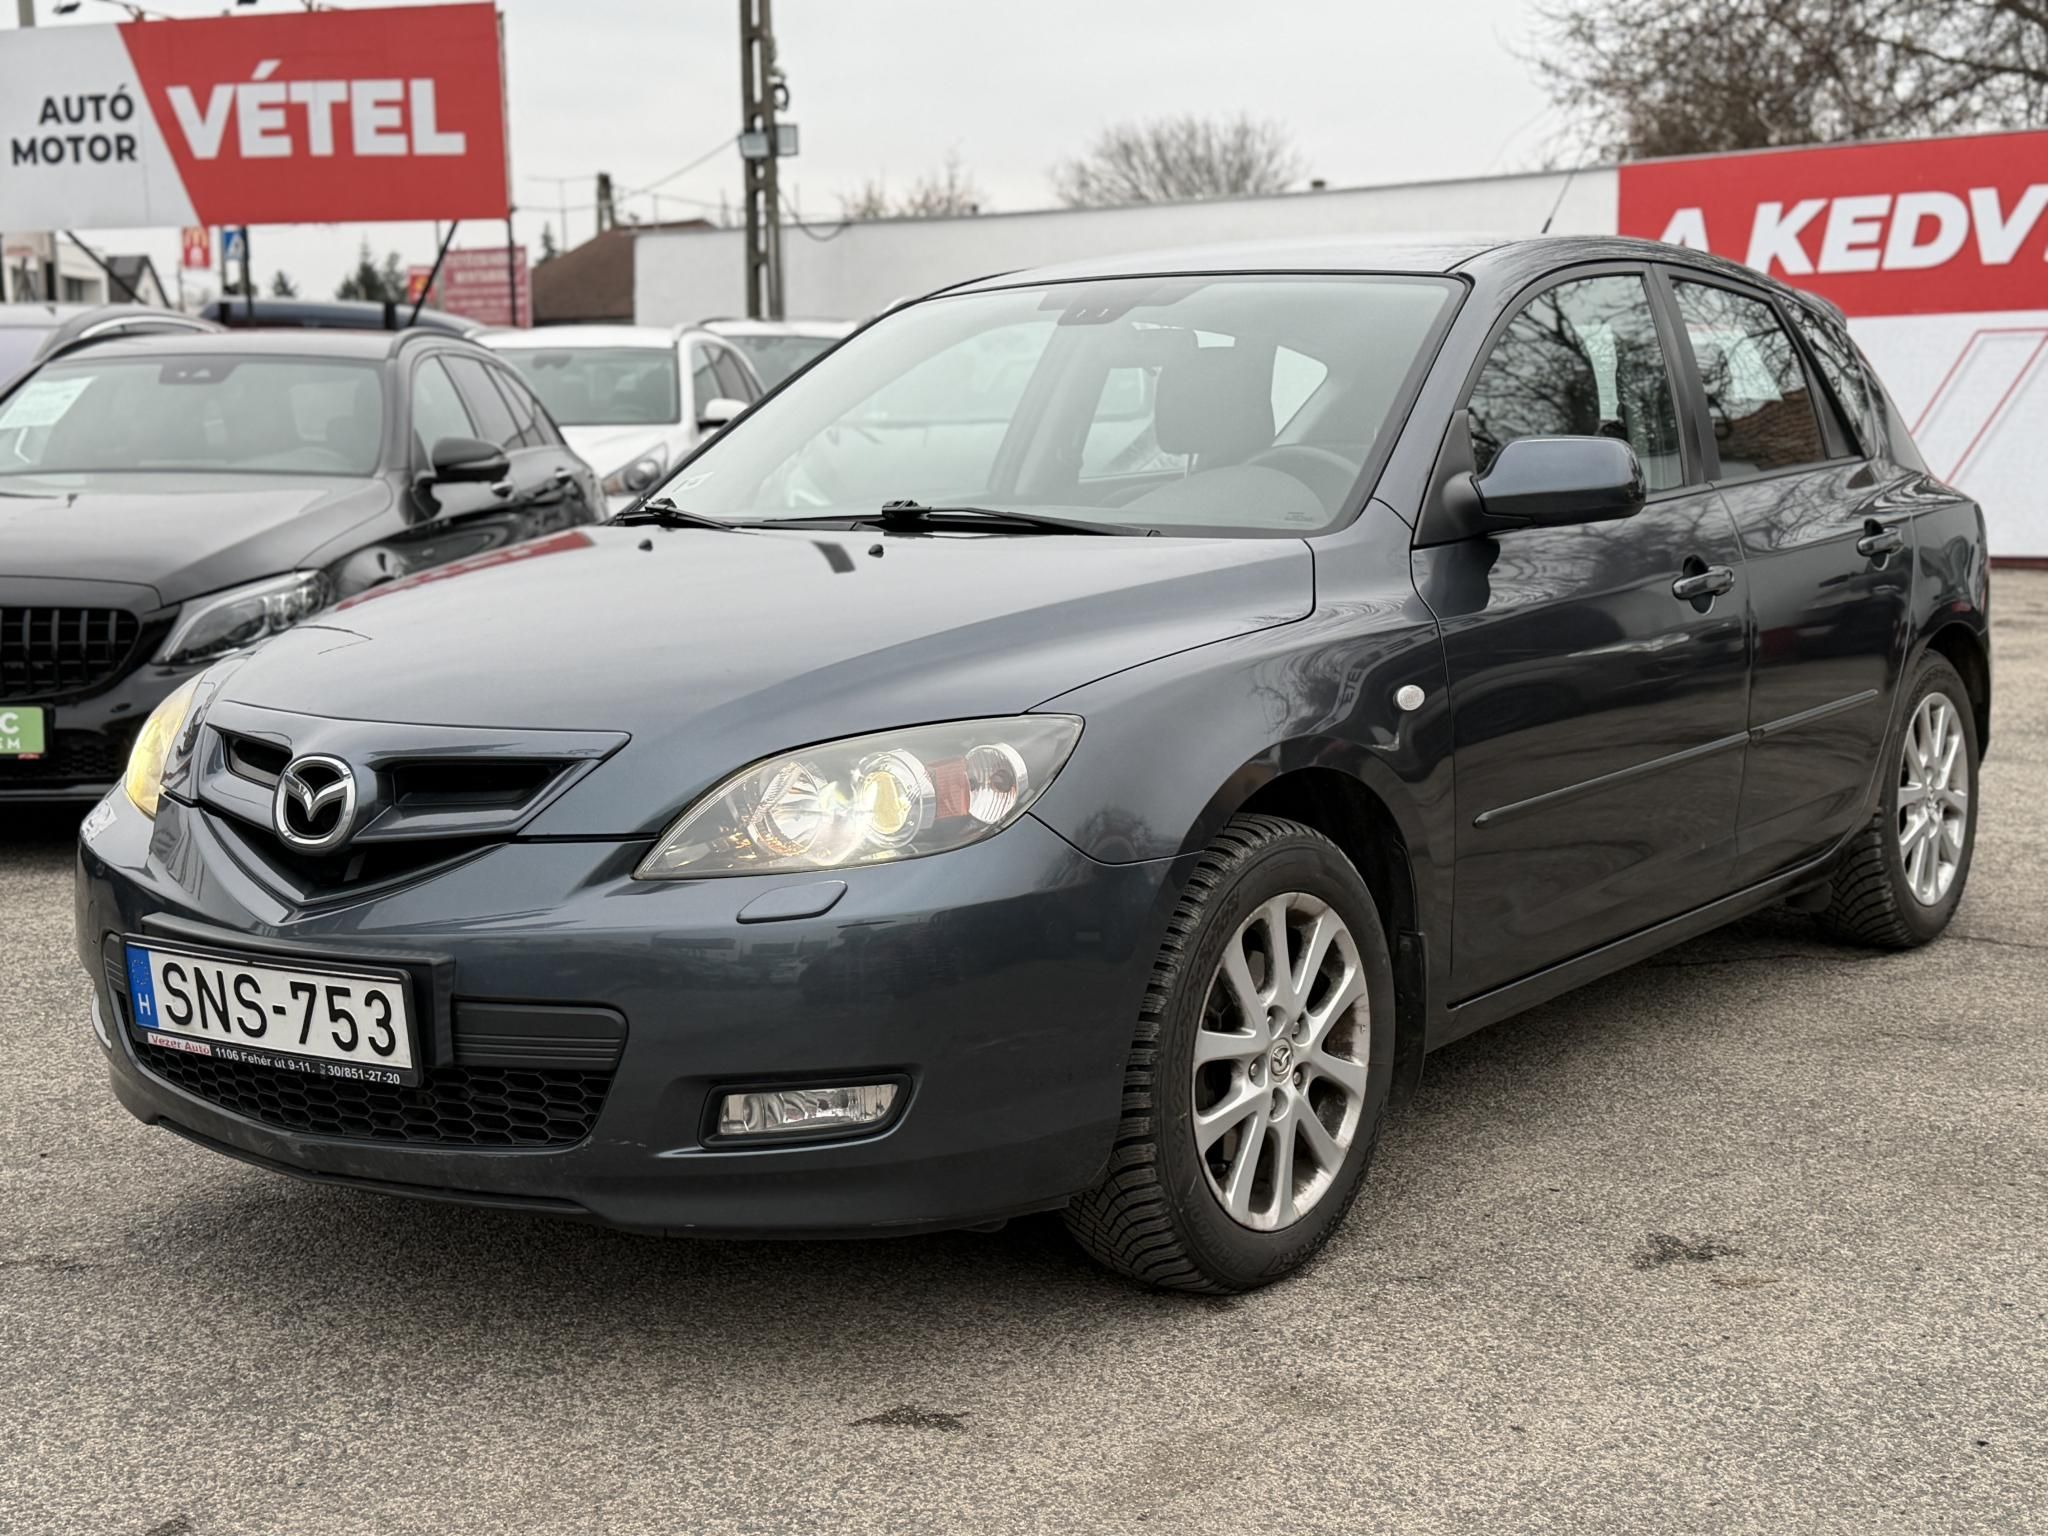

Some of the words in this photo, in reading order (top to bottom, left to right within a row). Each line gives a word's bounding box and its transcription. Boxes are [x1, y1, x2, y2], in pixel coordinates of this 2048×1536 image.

[38, 85, 134, 125] AUTÓ
[166, 59, 466, 159] VÉTEL
[11, 133, 137, 166] MOTOR
[1659, 207, 1710, 253] A
[1745, 183, 2048, 275] KEDV
[138, 992, 151, 1017] H
[162, 962, 396, 1057] SNS-753
[215, 1047, 239, 1061] 1106
[240, 1052, 271, 1067] Fehér
[287, 1060, 316, 1073] 9-11.
[327, 1064, 401, 1085] 30/851-27-20
